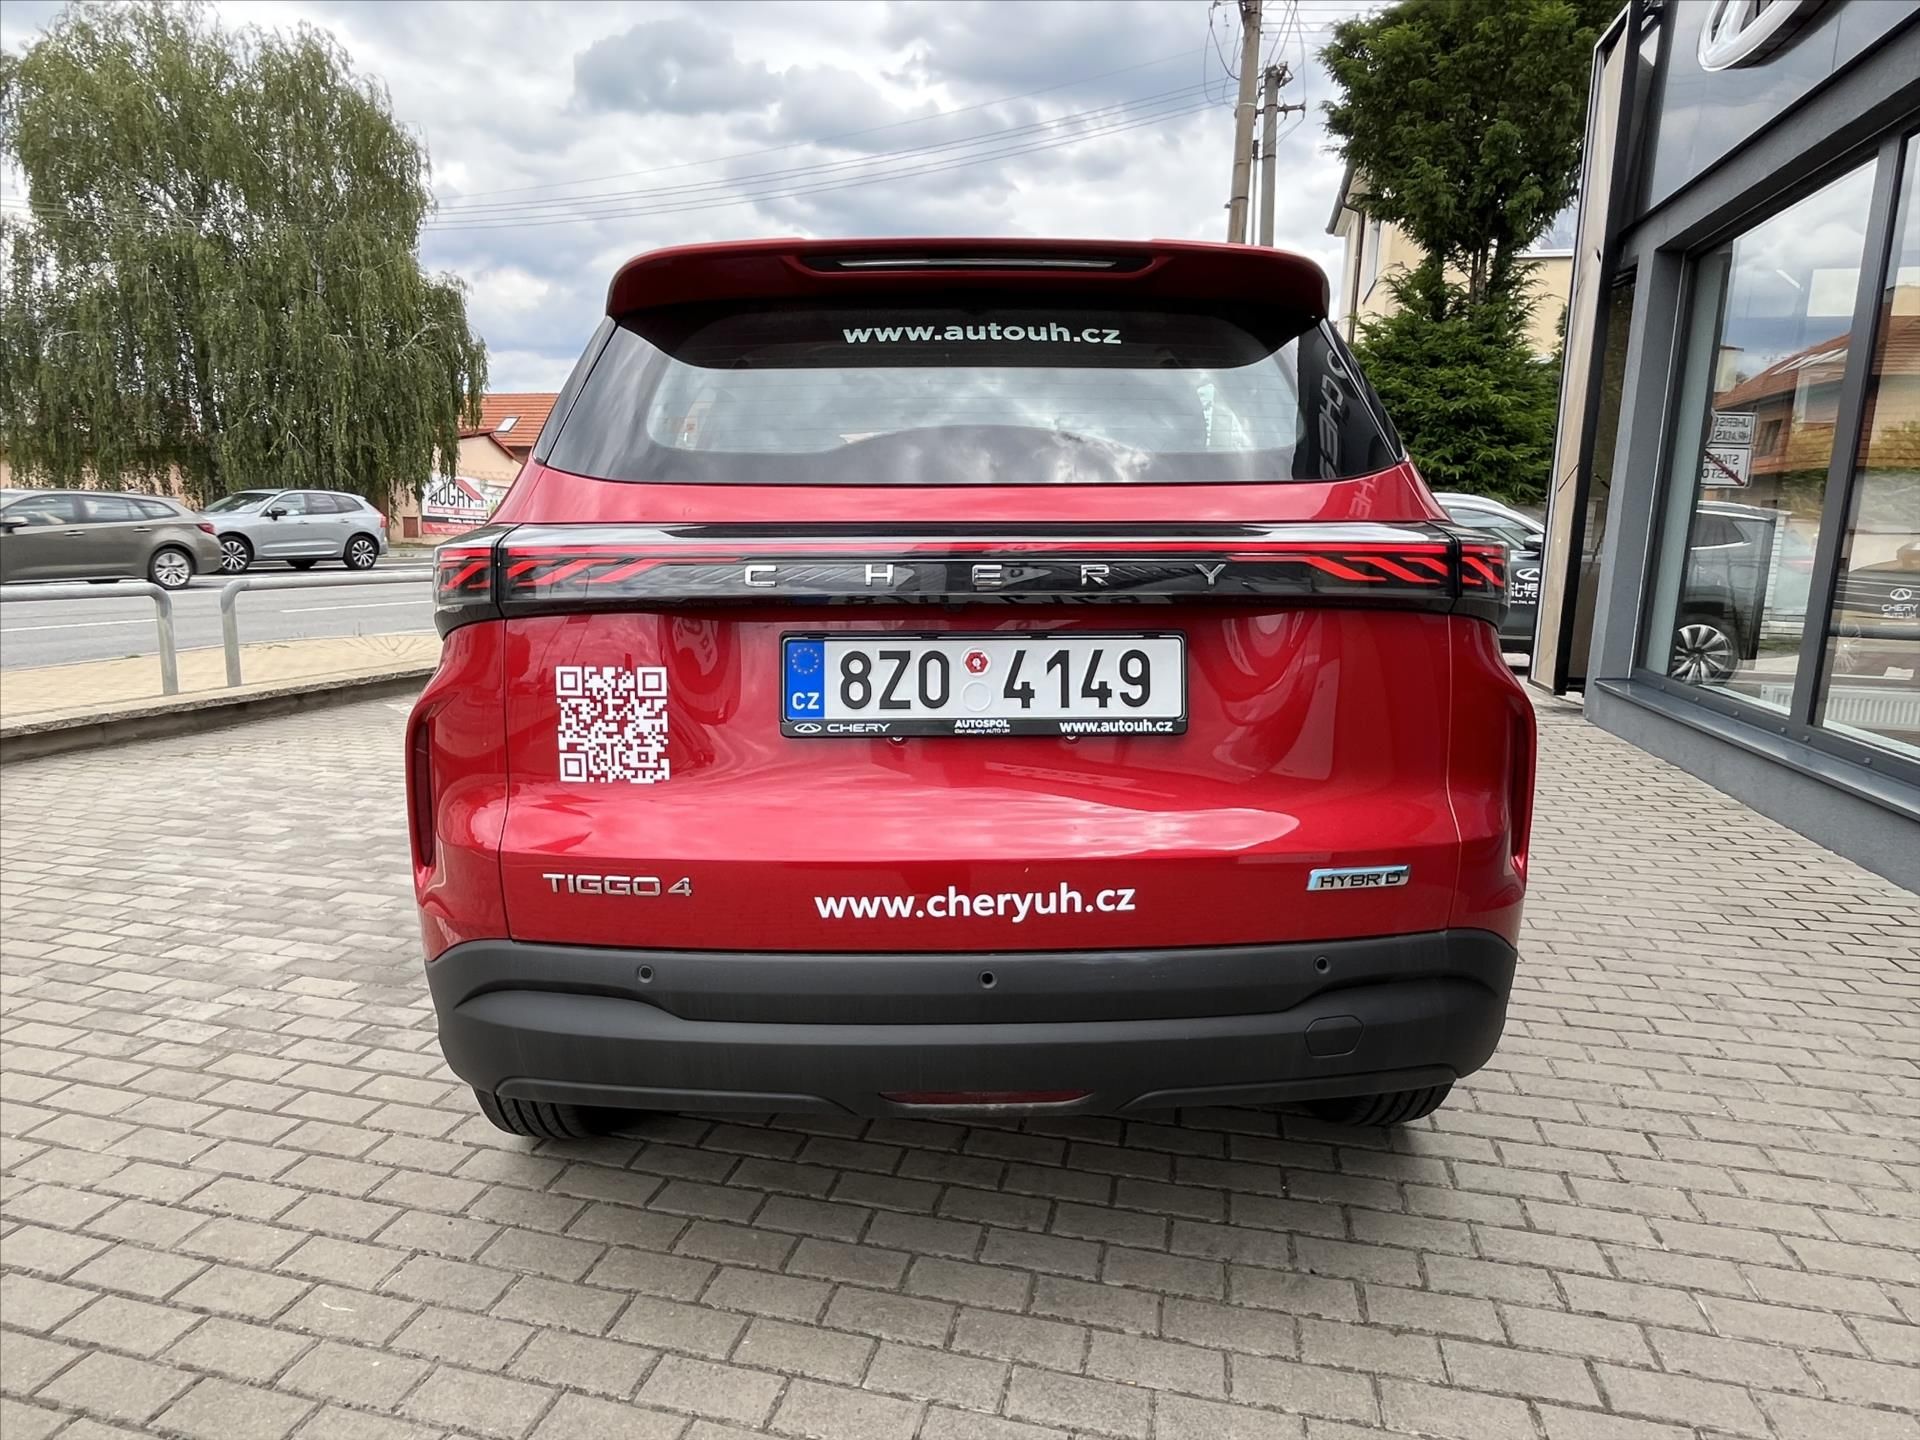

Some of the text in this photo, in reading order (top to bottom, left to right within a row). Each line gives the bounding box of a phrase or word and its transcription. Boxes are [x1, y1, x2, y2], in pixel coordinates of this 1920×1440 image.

[843, 322, 1122, 344] www.autouh.cz
[744, 563, 1226, 588] CHERY
[840, 649, 1151, 710] 8Z0 4149
[792, 692, 820, 710] CZ
[827, 723, 891, 733] CHERY
[954, 719, 1011, 728] AUTOSPOL
[1059, 719, 1174, 732] www.autouh.cz
[542, 873, 692, 897] TIGGO 4
[814, 882, 1136, 923] www.cheryuh.cz
